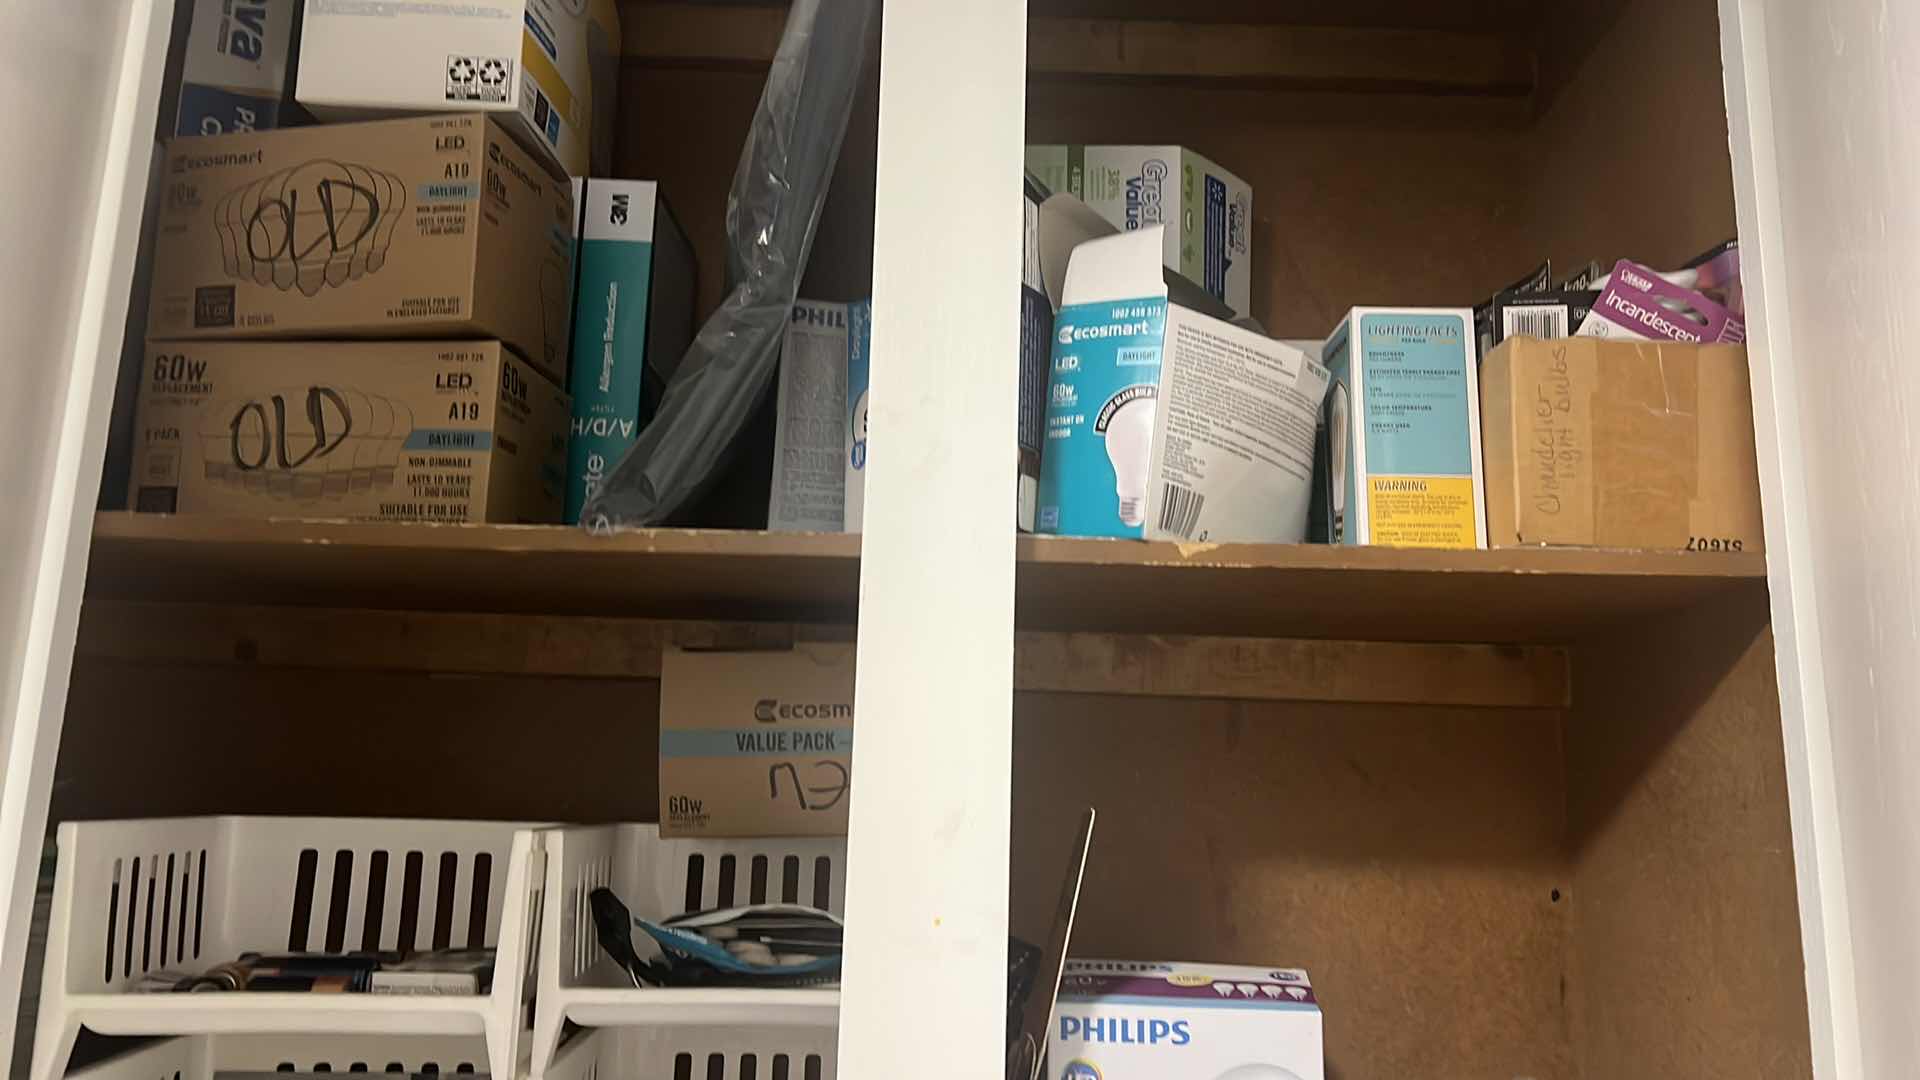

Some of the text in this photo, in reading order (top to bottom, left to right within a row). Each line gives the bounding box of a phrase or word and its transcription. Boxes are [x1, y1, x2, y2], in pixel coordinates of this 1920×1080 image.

[435, 135, 465, 153] LED
[187, 148, 262, 169] ecosmart
[610, 194, 629, 225] 3M
[1125, 176, 1141, 231] Value
[247, 177, 380, 262] OLD
[791, 305, 846, 329] PHIL
[1073, 319, 1149, 340] ecosmart
[1368, 325, 1457, 337] LIGHTING FACTS
[1123, 351, 1156, 360] DAYLIGHT
[153, 354, 207, 382] 60w
[435, 373, 473, 390] LED
[449, 402, 479, 421] A19
[229, 386, 352, 471] OLD
[571, 418, 634, 439] A/D/H
[428, 434, 475, 448] DAYLIGHT
[1375, 480, 1427, 491] WARNING
[379, 503, 467, 517] SUITABLE FOR USE
[736, 731, 836, 751] VALUE PACK
[1060, 1015, 1191, 1046] PHILIPS
